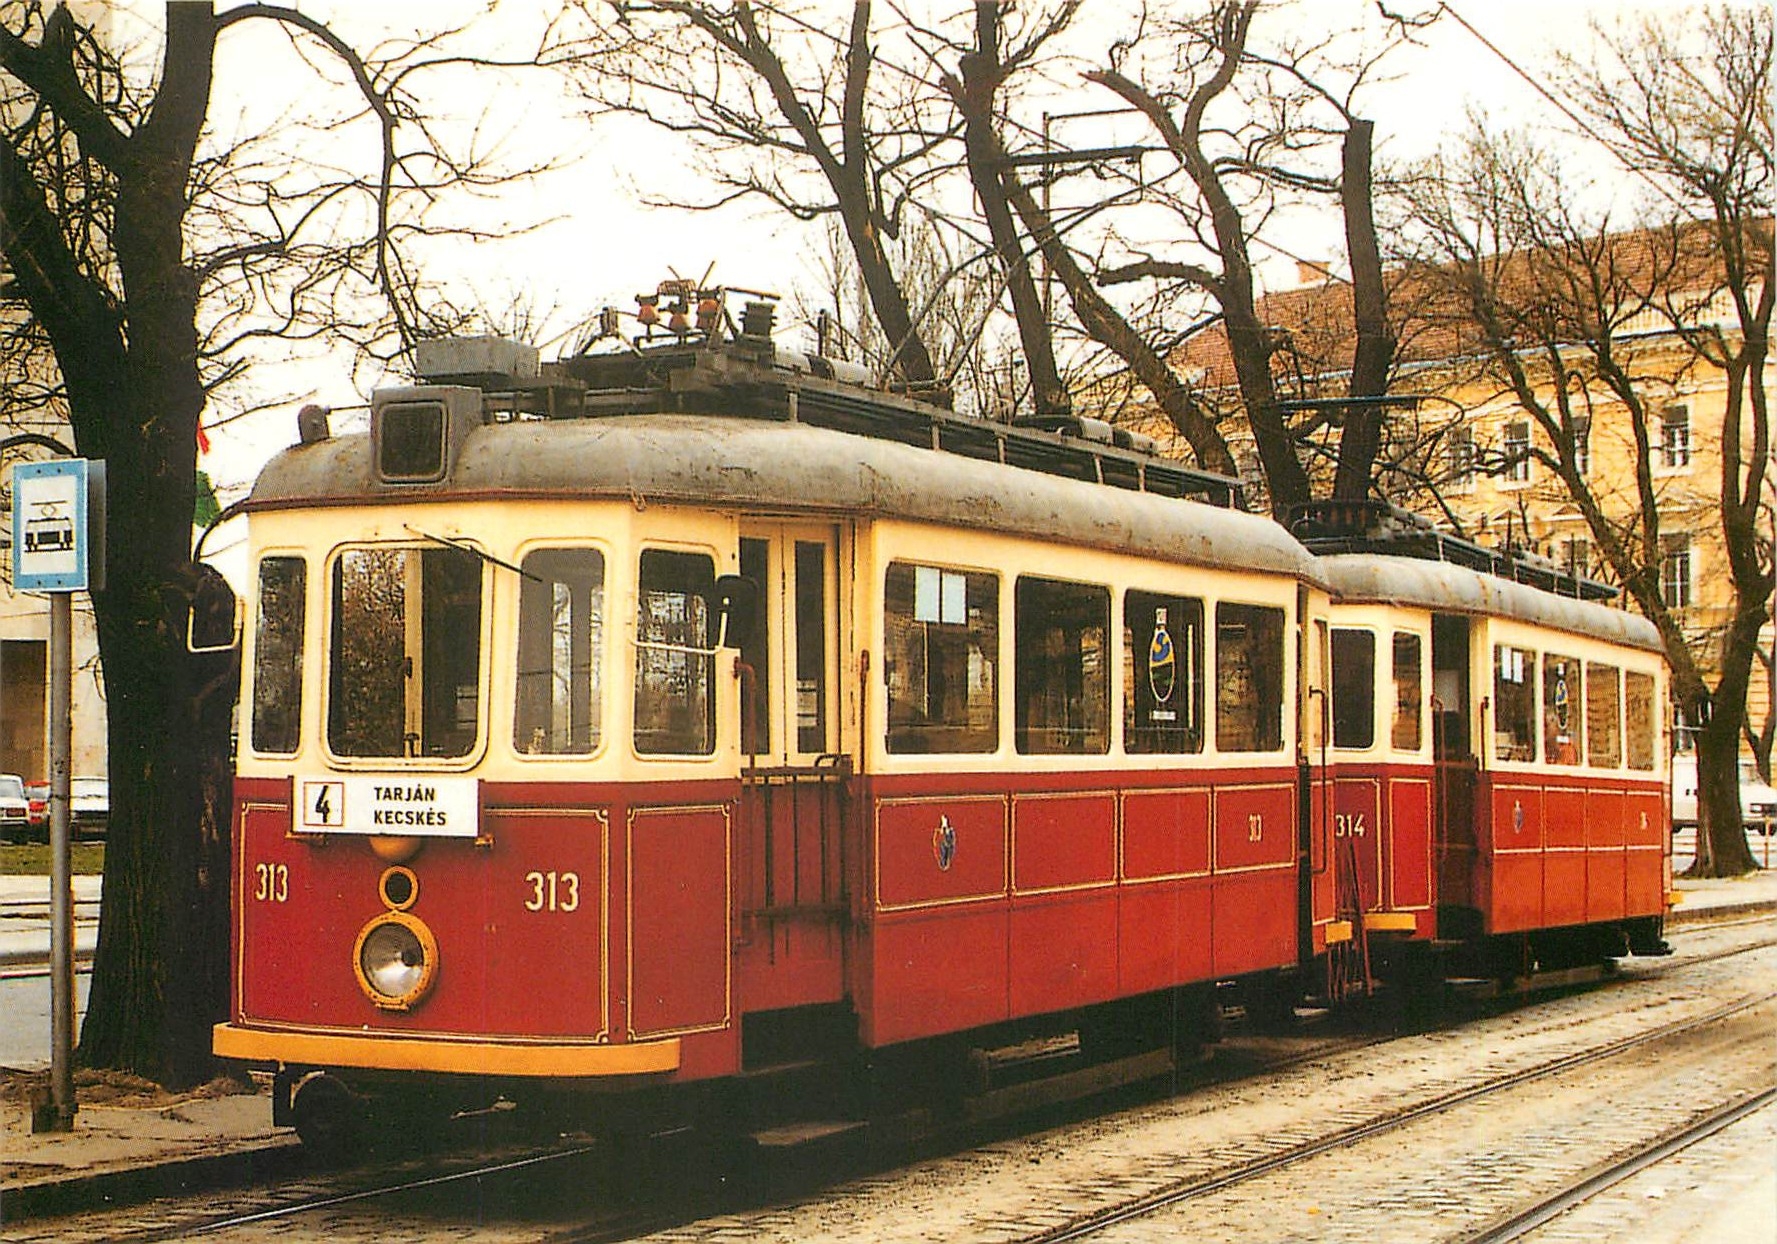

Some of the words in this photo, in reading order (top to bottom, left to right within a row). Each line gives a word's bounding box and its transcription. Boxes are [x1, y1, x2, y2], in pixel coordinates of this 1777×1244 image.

[315, 785, 330, 823] 4
[373, 784, 435, 801] TARJÁN
[373, 808, 447, 826] KECSKÉS
[1335, 814, 1365, 838] 314
[255, 863, 288, 902] 313
[524, 871, 579, 912] 313
